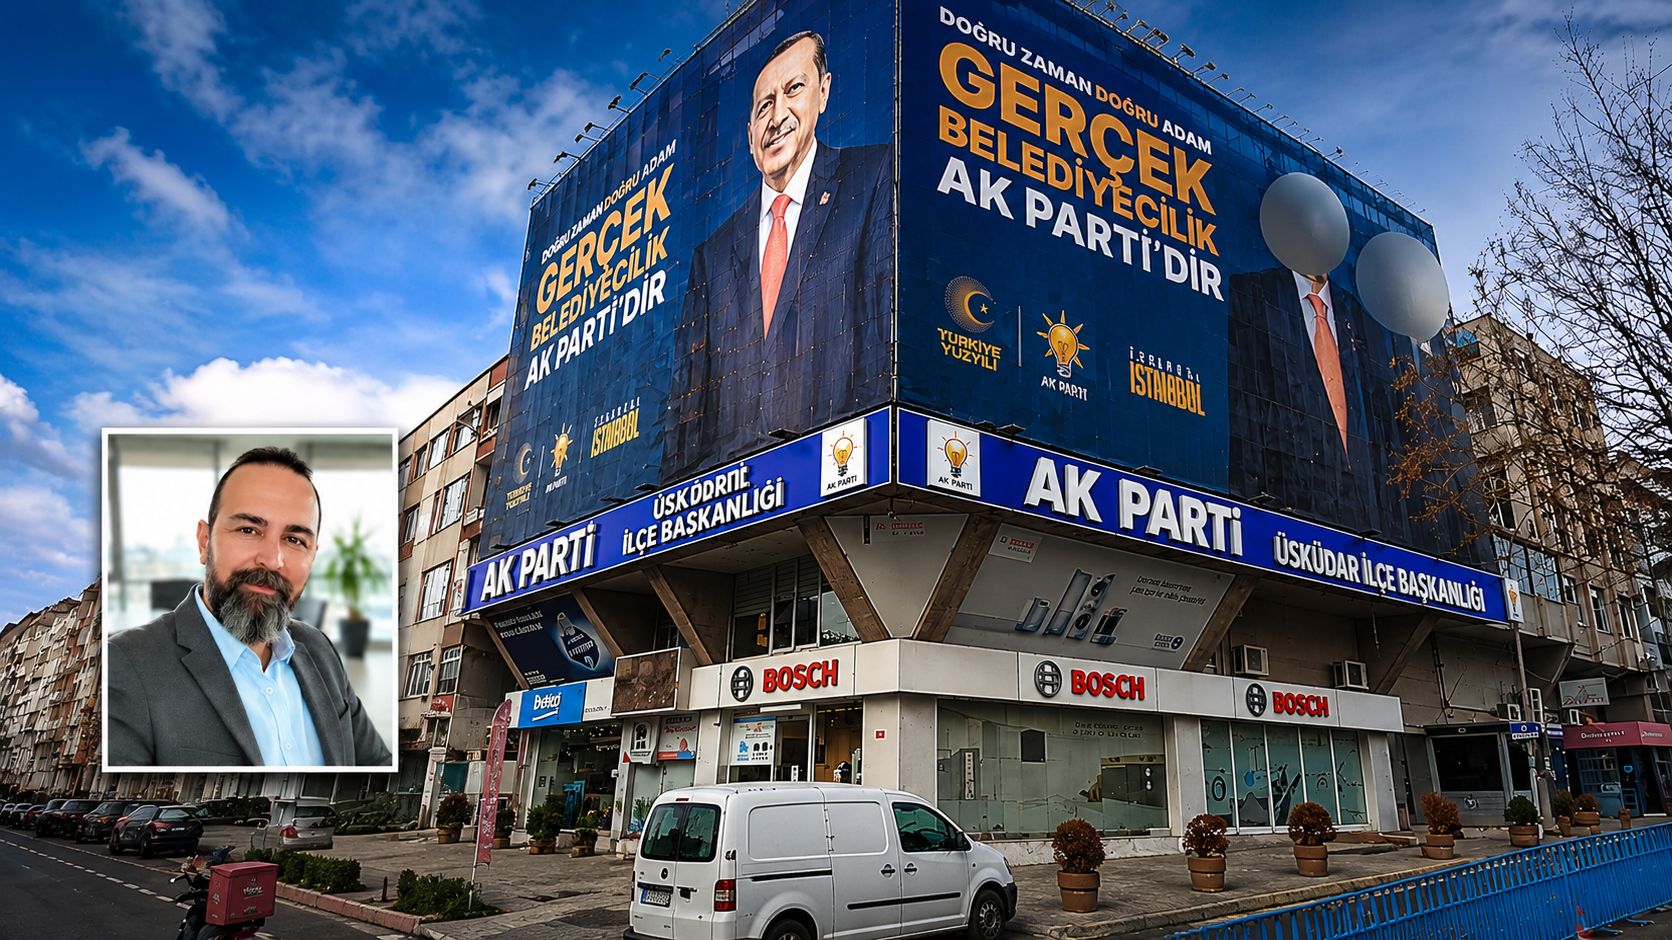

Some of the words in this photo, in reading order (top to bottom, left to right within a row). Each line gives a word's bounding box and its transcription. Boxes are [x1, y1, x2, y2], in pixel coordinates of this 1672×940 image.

[940, 6, 1016, 57] DOĞRU
[1021, 47, 1092, 97] ZAMAN
[1096, 84, 1158, 128] DOĞRU
[1162, 119, 1212, 155] ADAM
[939, 42, 1217, 216] GERÇEK
[571, 201, 603, 239] ZAMAN
[604, 170, 641, 212] DOĞRU
[641, 139, 677, 181] ADAM
[937, 156, 1014, 220] AK
[939, 105, 1219, 257] BELEDİYECİLİK
[537, 162, 675, 315] GERÇEK
[530, 225, 670, 352] BELEDİYECİLİK
[524, 343, 555, 391] AK
[938, 476, 949, 484] AK
[1023, 456, 1103, 523] AK
[622, 525, 657, 557] İLÇE
[1273, 531, 1361, 584] ÜSKÜDAR
[1361, 552, 1397, 594] İLÇE
[1397, 567, 1487, 613] BAŞKANLIĞI
[480, 555, 517, 602] AK
[763, 659, 839, 693] BOSCH
[1071, 669, 1146, 701] BOSCH
[1272, 691, 1330, 718] BOSCH
